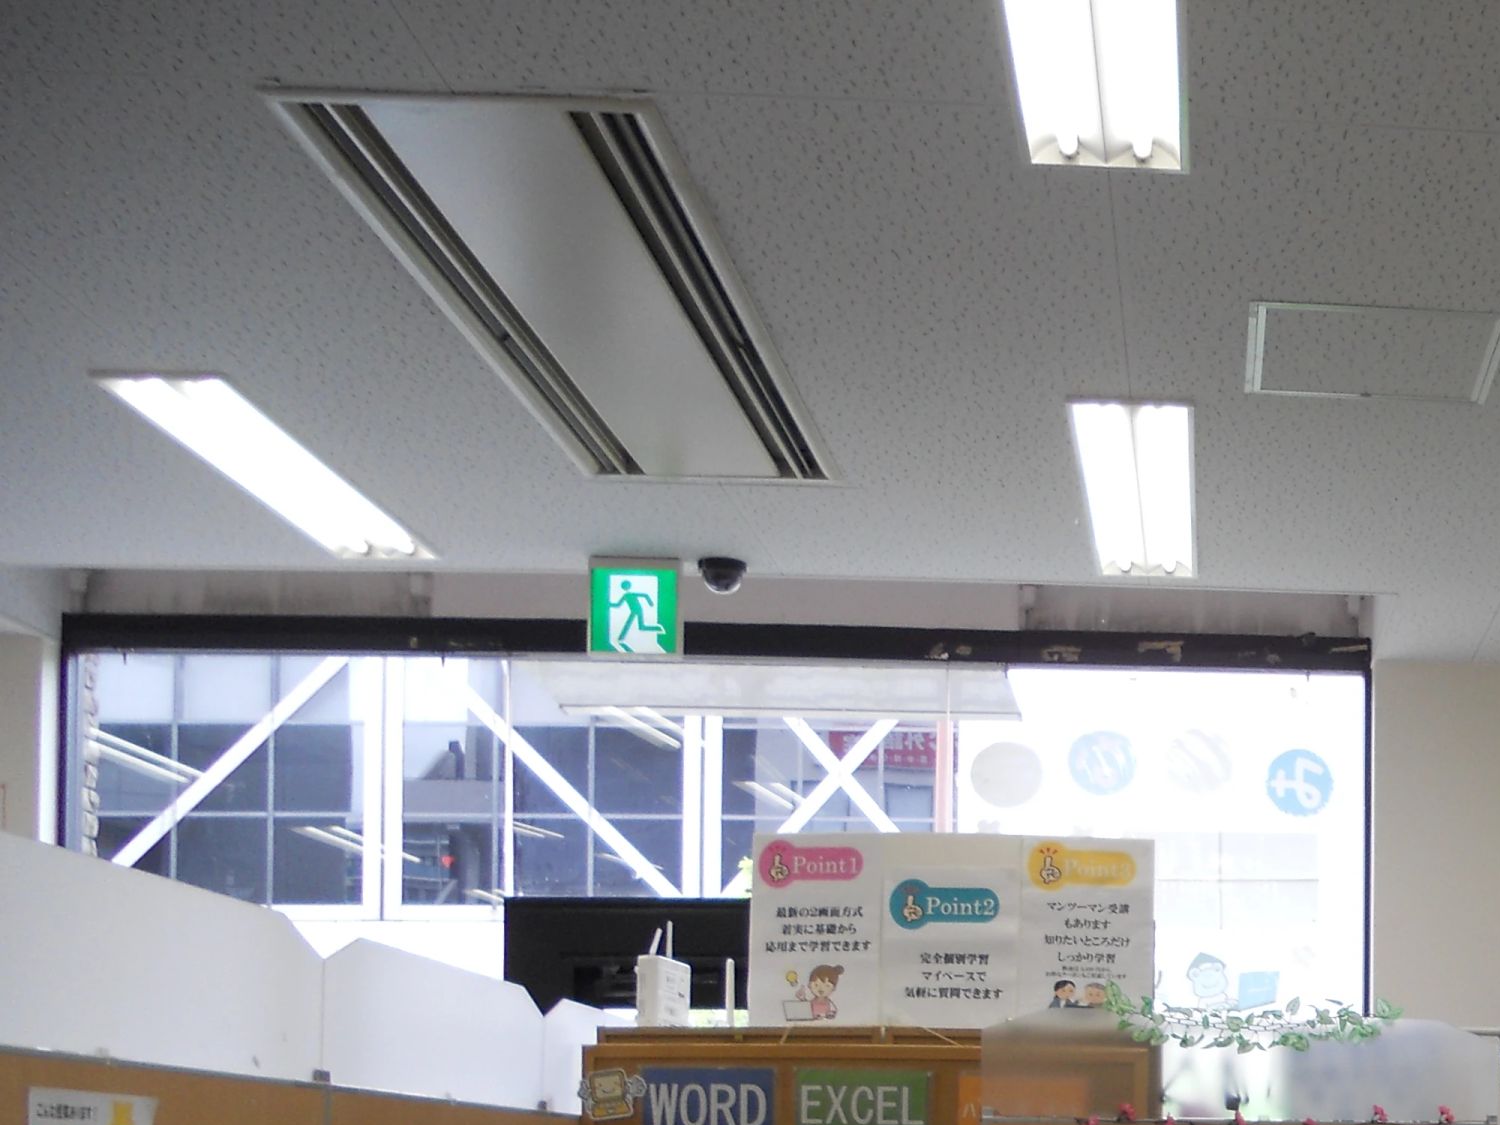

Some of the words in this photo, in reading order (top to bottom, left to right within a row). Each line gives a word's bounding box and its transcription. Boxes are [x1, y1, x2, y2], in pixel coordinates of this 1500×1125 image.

[793, 856, 858, 876] Point1
[925, 897, 995, 916] Point2
[1064, 918, 1111, 930] もあります
[920, 953, 990, 966] 完全個別学習
[922, 971, 987, 982] マイペースで
[800, 1084, 925, 1125] EXCEL
